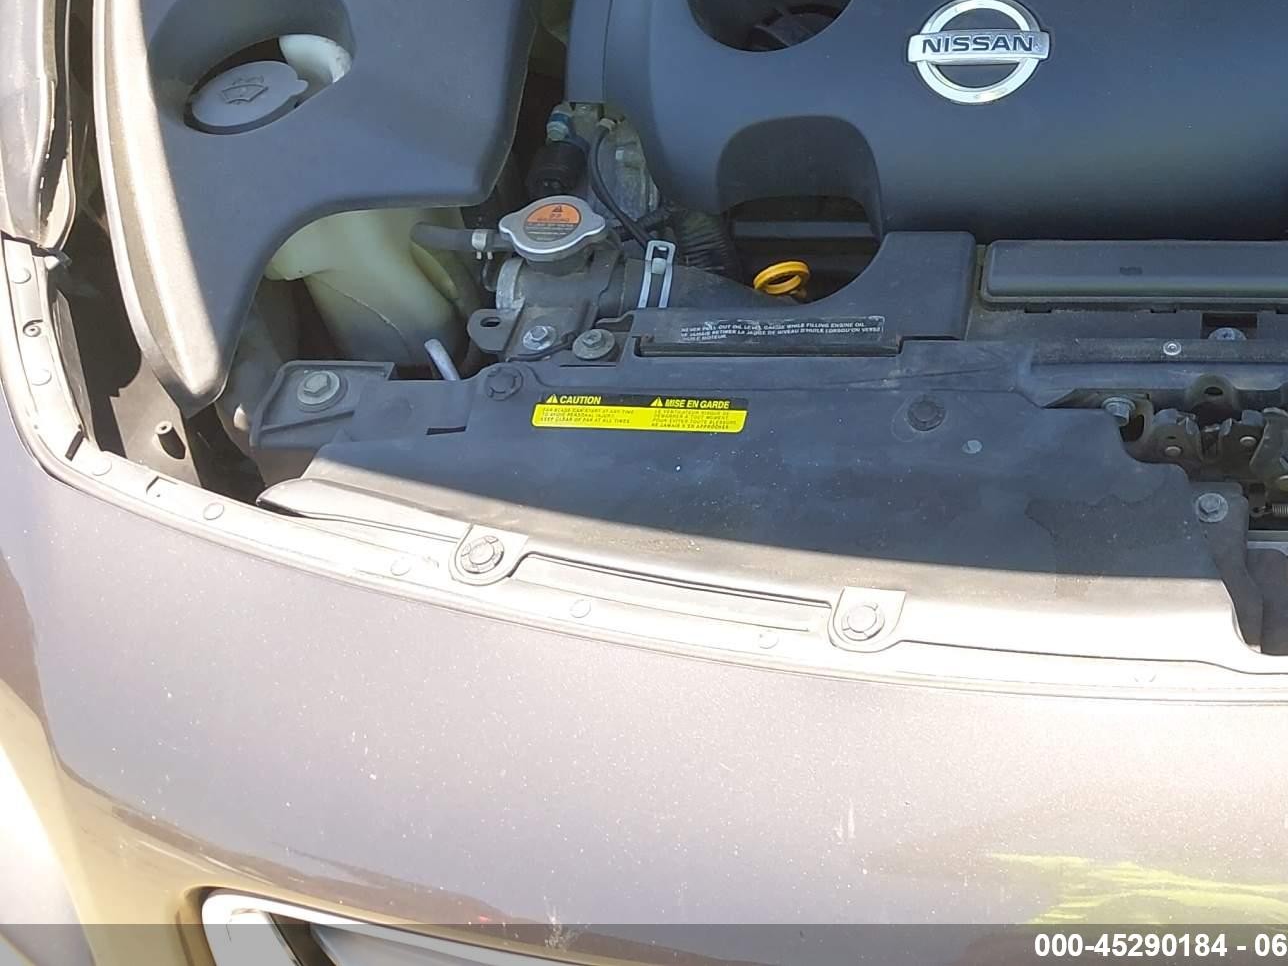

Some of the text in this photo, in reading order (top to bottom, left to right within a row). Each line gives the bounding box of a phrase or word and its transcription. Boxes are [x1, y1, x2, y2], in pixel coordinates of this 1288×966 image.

[922, 36, 1033, 54] NISSAN
[560, 395, 602, 405] CAUTION
[664, 398, 731, 409] MISE EN GARDE
